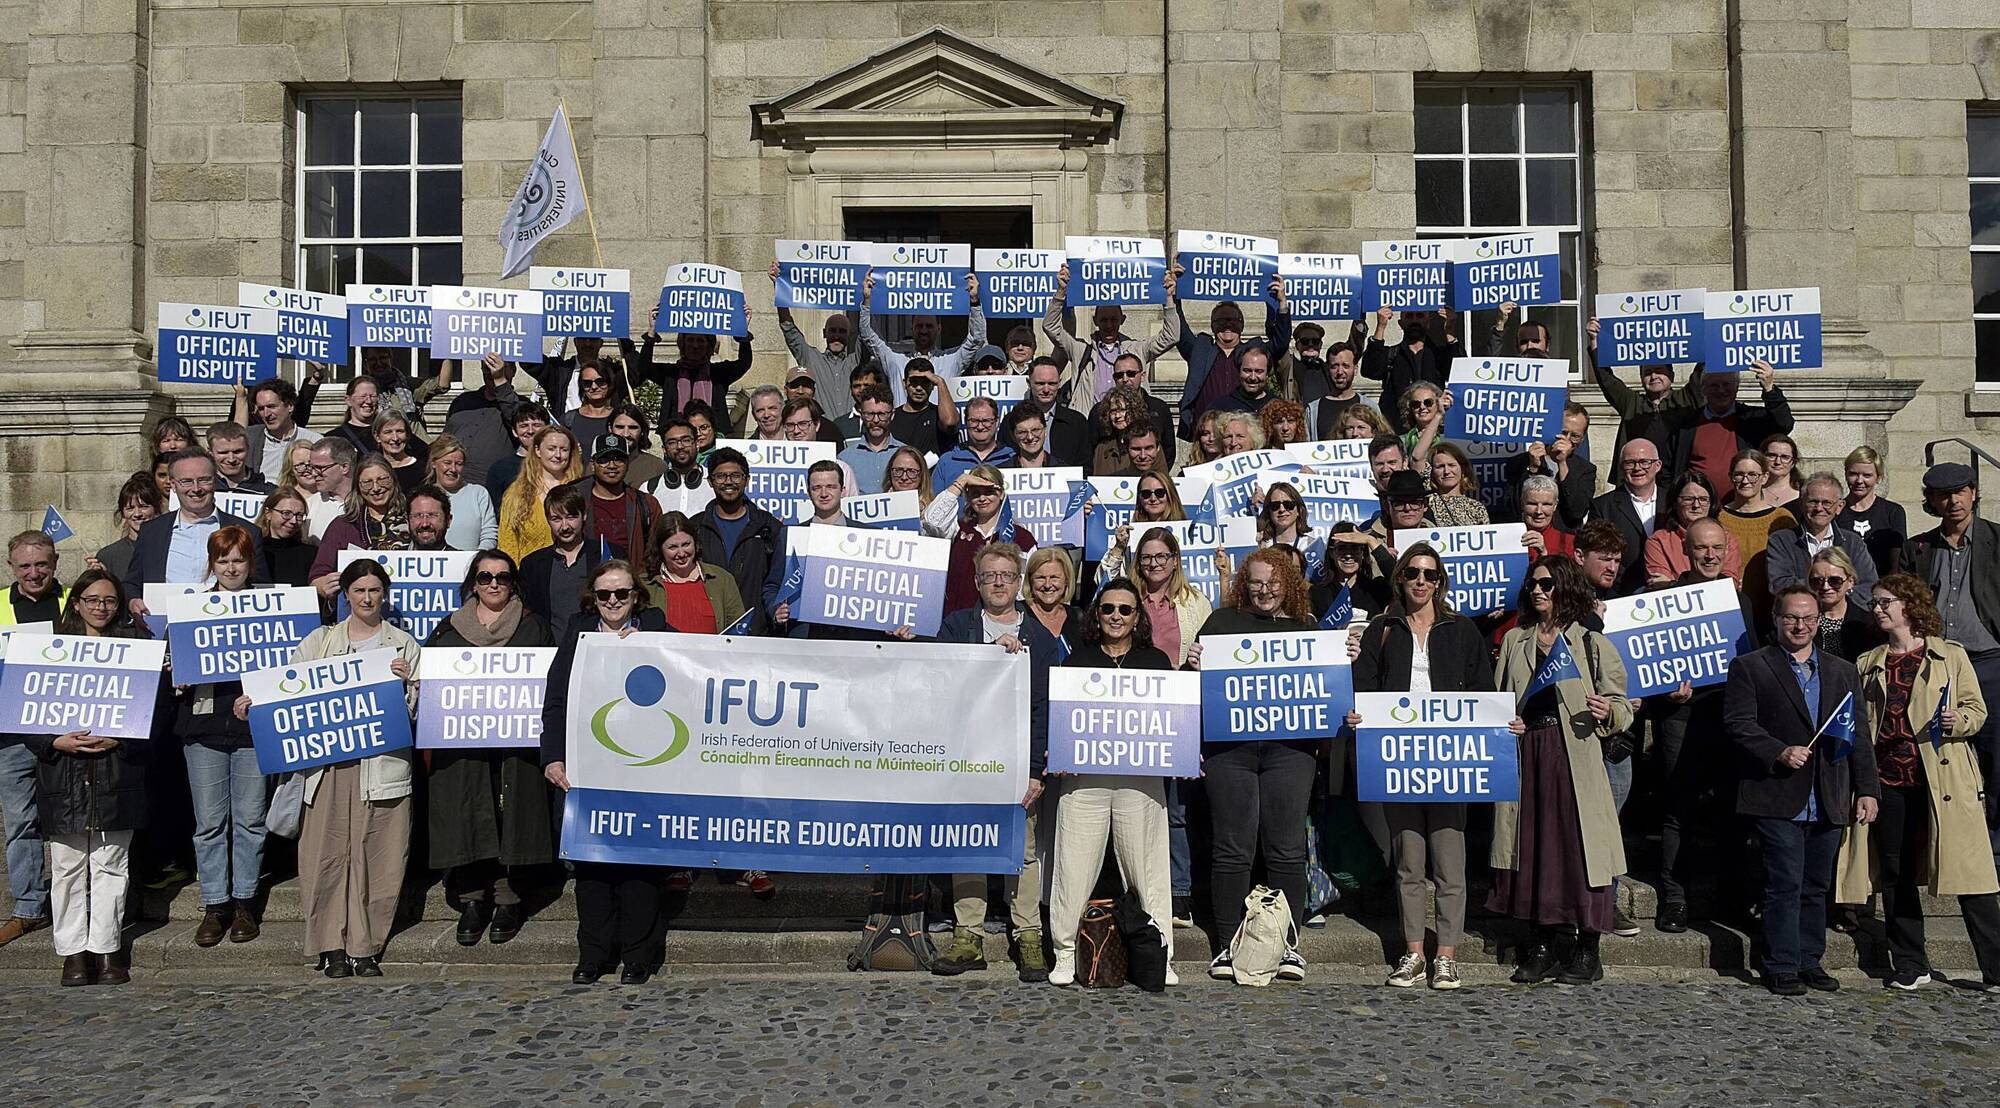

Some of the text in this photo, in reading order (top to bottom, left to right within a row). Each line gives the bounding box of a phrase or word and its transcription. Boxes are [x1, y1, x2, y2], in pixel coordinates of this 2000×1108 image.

[815, 245, 851, 261] IFUT
[1106, 240, 1141, 254] IFUT
[1220, 236, 1256, 252] IFUT
[1404, 245, 1441, 260] IFUT
[1496, 238, 1534, 256] IFUT
[912, 248, 948, 264] IFUT
[1016, 254, 1048, 268] IFUT
[1192, 257, 1263, 276] OFFICIAL
[1308, 257, 1344, 270] IFUT
[571, 272, 607, 288] IFUT
[694, 266, 726, 285] IFUT
[790, 266, 858, 286] OFFICIAL
[886, 269, 956, 289] OFFICIAL
[1081, 260, 1152, 280] OFFICIAL
[1377, 268, 1449, 286] OFFICIAL
[1470, 261, 1543, 283] OFFICIAL
[990, 276, 1057, 293] OFFICIAL
[1084, 282, 1149, 301] DISPUTE
[1194, 277, 1259, 296] DISPUTE
[1284, 278, 1352, 296] OFFICIAL
[1473, 282, 1540, 304] DISPUTE
[285, 293, 322, 311] IFUT
[390, 289, 427, 303] IFUT
[478, 292, 518, 309] IFUT
[545, 294, 614, 312] OFFICIAL
[669, 290, 734, 311] OFFICIAL
[792, 286, 855, 306] DISPUTE
[889, 291, 952, 310] DISPUTE
[1380, 288, 1445, 307] DISPUTE
[1642, 294, 1681, 311] IFUT
[1752, 294, 1793, 312] IFUT
[209, 311, 251, 330] IFUT
[279, 316, 332, 338] FICIAL
[448, 315, 526, 335] OFFICIAL
[547, 315, 611, 332] DISPUTE
[670, 310, 732, 331] DISPUTE
[1614, 318, 1691, 339] OFFICIAL
[366, 326, 432, 343] DISPUTE
[1722, 320, 1804, 343] OFFICIAL
[177, 335, 260, 358] OFFICIAL
[277, 336, 329, 358] SPUTE
[450, 336, 522, 356] DISPUTE
[1617, 340, 1688, 360] DISPUTE
[1725, 344, 1801, 366] DISPUTE
[179, 358, 256, 380] DISPUTE
[1498, 362, 1543, 382] IFUT
[974, 380, 1011, 396] IFUT
[1464, 389, 1548, 413] OFFICIAL
[1465, 414, 1543, 438] DISPUTE
[766, 446, 809, 464] IFUT
[1490, 442, 1518, 454] IFU
[1231, 452, 1272, 476] IFUT
[749, 472, 808, 494] FFICIA
[1013, 473, 1055, 490] IFUT
[1308, 479, 1350, 495] IFUT
[226, 498, 263, 518] IFU
[848, 498, 890, 519] IFUT
[1183, 524, 1228, 545] IFUT
[1450, 531, 1497, 552] IFUT
[865, 536, 918, 561] IFUT
[398, 557, 448, 578] IFUT
[1444, 560, 1510, 584] FICIAL
[825, 565, 923, 598] OFFICIAL
[232, 593, 285, 613] IFUT
[390, 589, 459, 612] FICIAL
[1445, 587, 1506, 611] SPUTE
[1655, 590, 1704, 618] IFUT
[824, 594, 918, 627] DISPUTE
[194, 621, 302, 648] OFFICIAL
[1628, 620, 1728, 659] OFFICIAL
[72, 642, 131, 664] IFUT
[1262, 638, 1316, 662] IFUT
[482, 653, 536, 673] IFUT
[1637, 650, 1728, 688] DISPUTE
[308, 659, 364, 689] IFUT
[23, 672, 133, 699] OFFICIAL
[1112, 675, 1165, 697] IFUT
[1225, 674, 1330, 702] OFFICIAL
[441, 685, 544, 710] OFFICIAL
[704, 678, 819, 728] IFUT
[20, 701, 126, 728] DISPUTE
[273, 692, 384, 733] OFFICIAL
[1230, 705, 1328, 732] DISPUTE
[1422, 698, 1479, 722] IFUT
[444, 714, 541, 740] DISPUTE
[1072, 709, 1177, 736] OFFICIAL
[282, 721, 385, 764] DISPUTE
[701, 733, 945, 755] Irish Federation of University Teachers
[1381, 735, 1493, 761] OFFICIAL
[701, 750, 1004, 774] Cónaidhm Éireannach na Múinteoirí Ollscoile
[1074, 740, 1172, 767] DISPUTE
[1386, 768, 1489, 794] DISPUTE
[590, 810, 636, 836] IFUT
[658, 815, 699, 840] THE
[708, 817, 790, 844] HIGHER
[800, 821, 922, 848] EDUCATION
[930, 824, 999, 846] UNION
